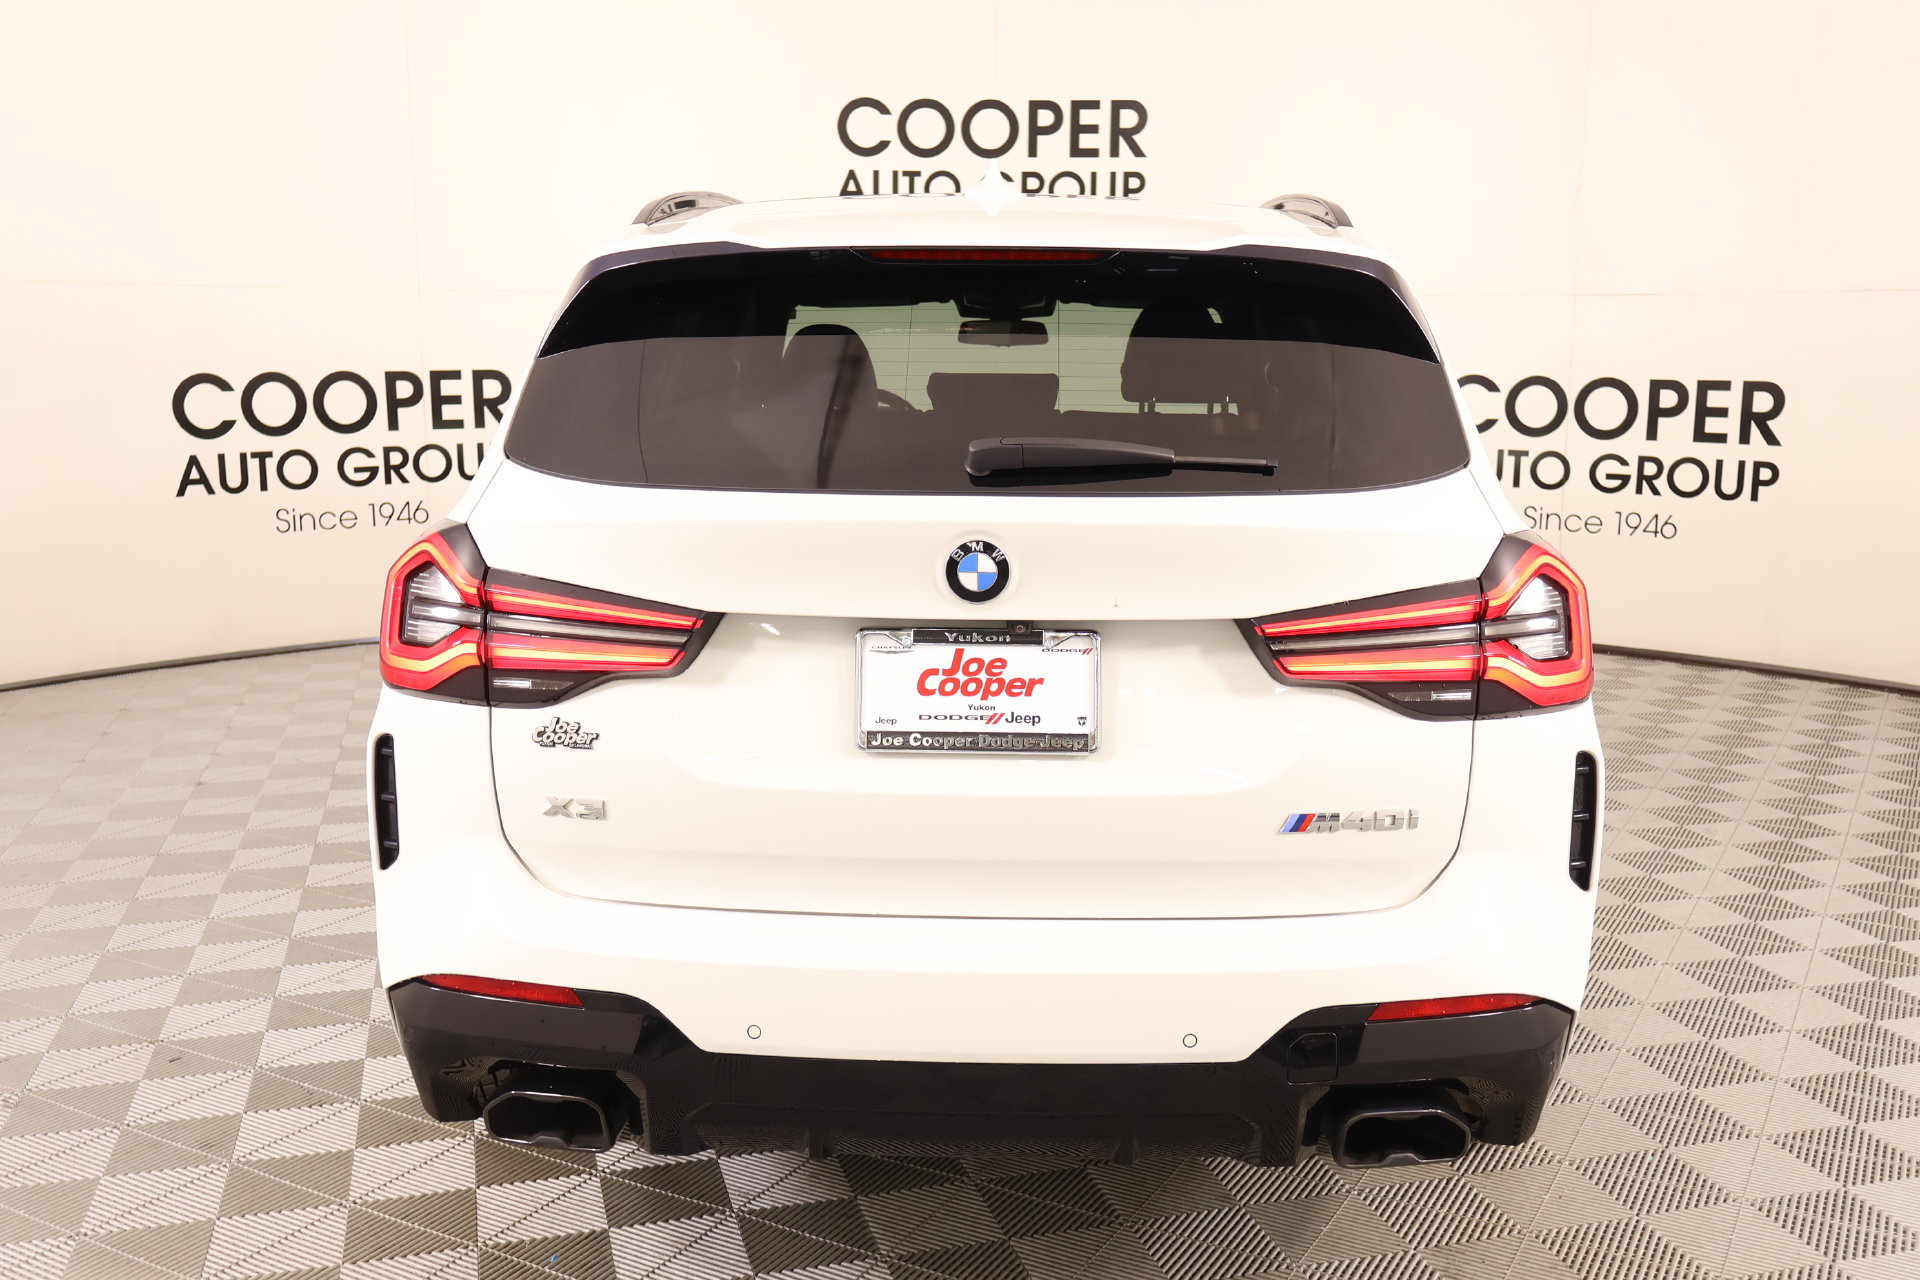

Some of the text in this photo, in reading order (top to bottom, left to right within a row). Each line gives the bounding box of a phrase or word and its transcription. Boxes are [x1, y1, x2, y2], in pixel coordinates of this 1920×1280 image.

[837, 97, 1148, 159] COOPER
[839, 169, 1147, 198] AUTO ROUP
[172, 369, 512, 440] COOPER
[1456, 374, 1786, 447] COOPER
[175, 442, 484, 498] AUTO GROU
[1496, 448, 1780, 503] TO GROUP
[275, 499, 430, 534] Since 1946
[1523, 505, 1678, 540] Since 1946
[950, 541, 1006, 563] BMW
[944, 631, 1012, 643] Yukon
[942, 648, 1008, 677] Joe
[916, 668, 1045, 701] Cooper
[874, 716, 898, 726] Jeep
[918, 711, 1041, 726] DODGE Jeep
[967, 703, 996, 711] Yukon
[532, 727, 599, 746] Cooper
[544, 717, 581, 733] Joe
[871, 733, 904, 747] Joe
[909, 733, 972, 749] Cooper
[542, 796, 607, 821] X3
